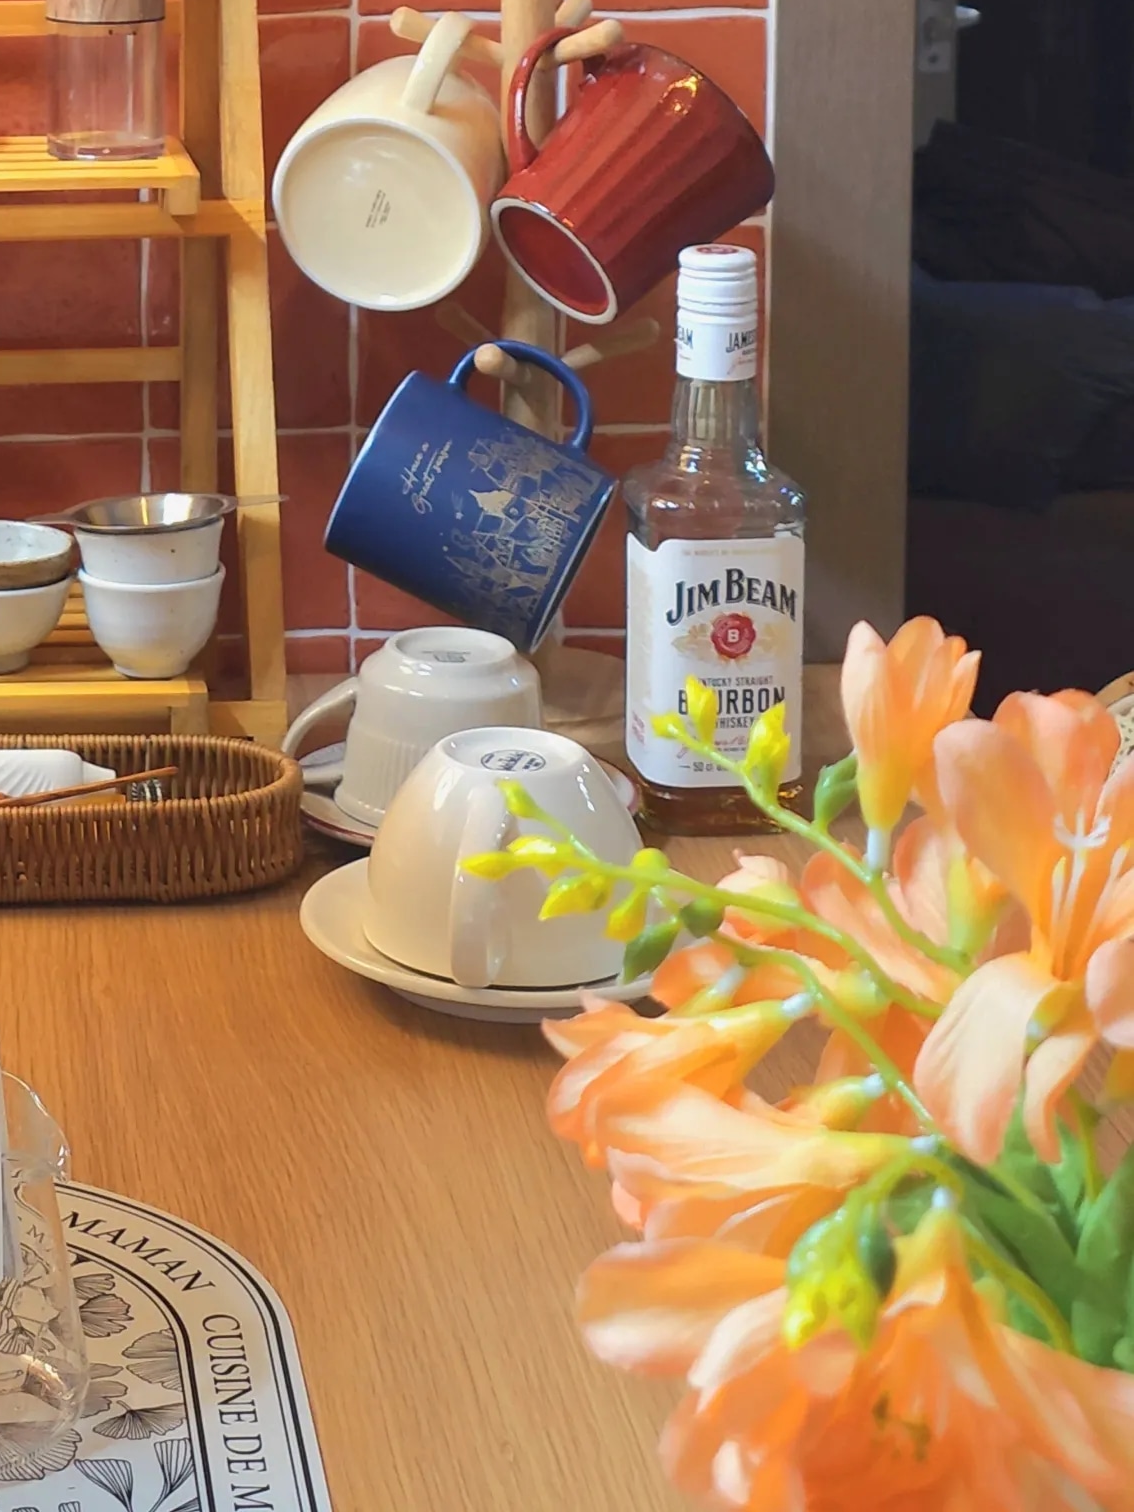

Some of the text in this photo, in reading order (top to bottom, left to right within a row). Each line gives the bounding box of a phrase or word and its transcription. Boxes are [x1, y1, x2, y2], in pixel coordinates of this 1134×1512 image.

[665, 567, 797, 626] JIM BEAM
[678, 686, 785, 716] BURBON
[698, 677, 732, 687] NTUCKY
[714, 716, 754, 729] HISKEY
[60, 1210, 216, 1293] MAMAN
[201, 1313, 260, 1426] CUISINE
[222, 1433, 268, 1475] DE
